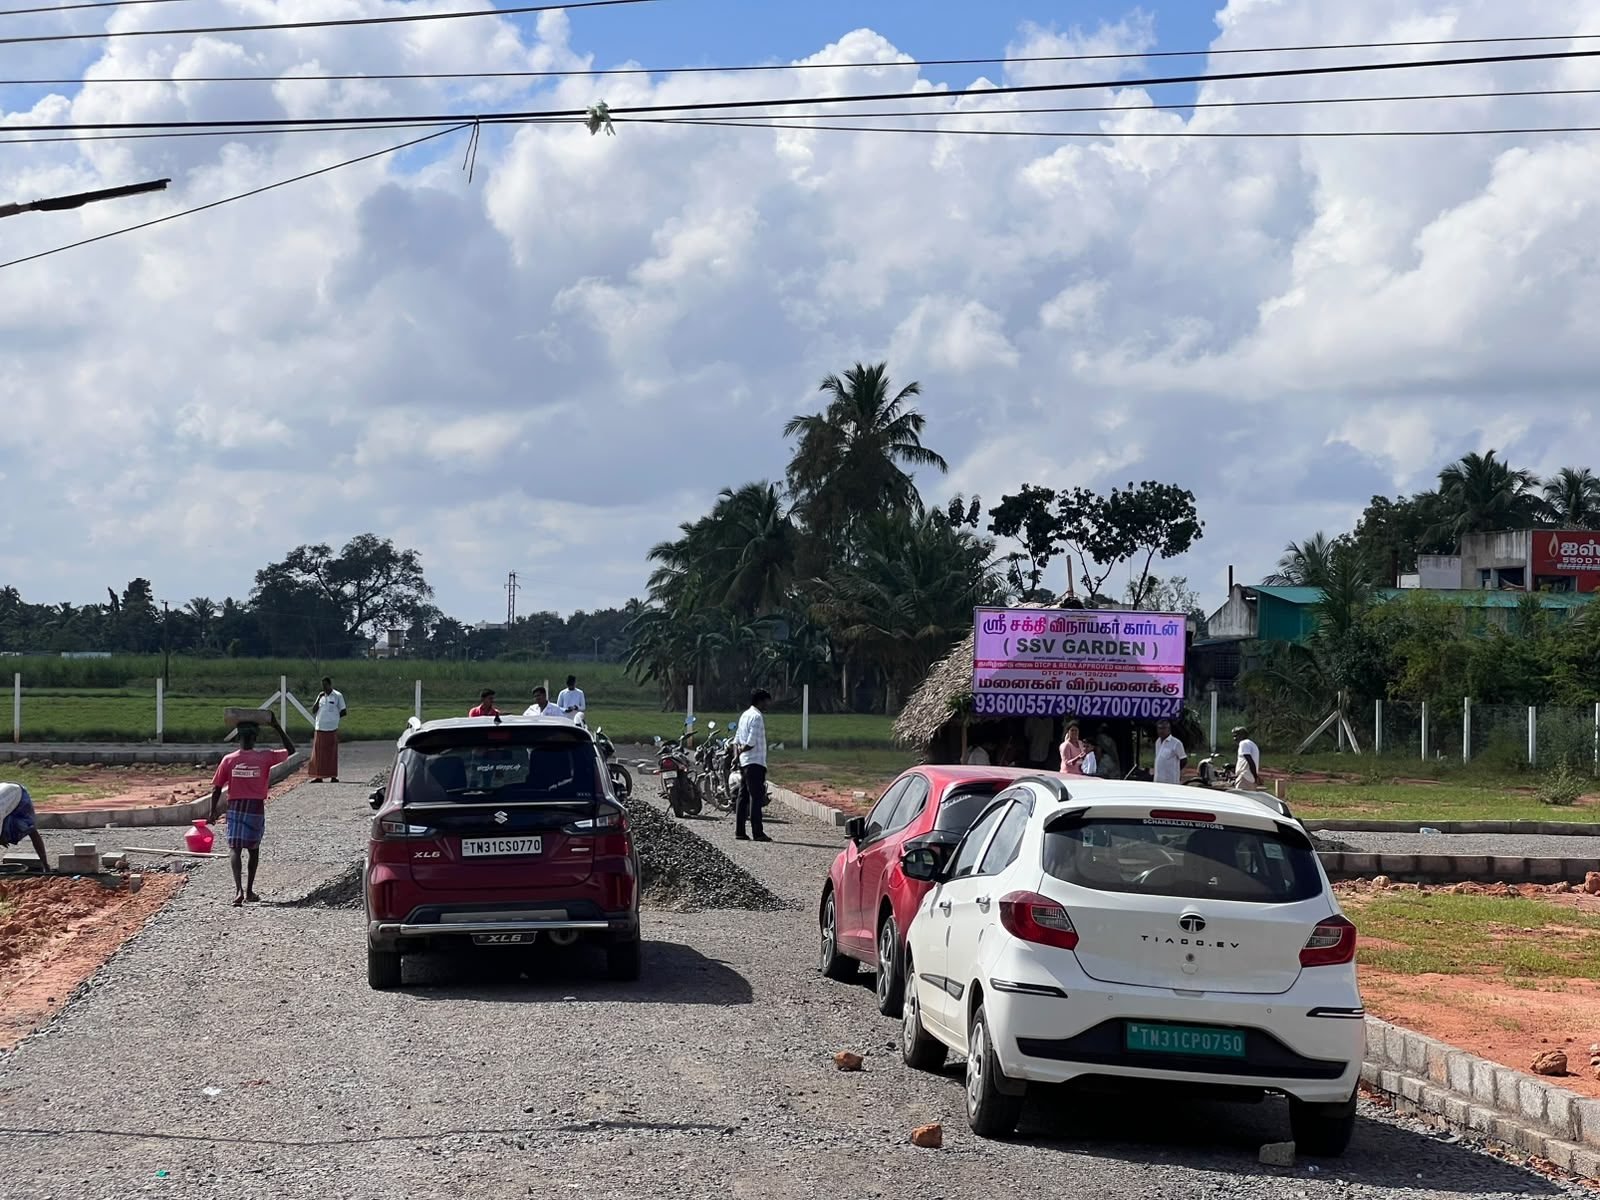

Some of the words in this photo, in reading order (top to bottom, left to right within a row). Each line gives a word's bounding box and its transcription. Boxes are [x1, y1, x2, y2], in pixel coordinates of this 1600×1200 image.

[983, 613, 1007, 635] ஸ்ரீ
[1011, 616, 1048, 636] சக்தி
[1050, 616, 1119, 637] விநாயகர்
[1123, 620, 1179, 637] கார்டன்
[1016, 638, 1056, 654] SSV
[1062, 639, 1146, 657] GARDEN
[1034, 662, 1052, 670] DTCP
[1058, 663, 1077, 671] RERA
[978, 677, 1062, 691] மனைகள்
[1066, 677, 1180, 695] விற்பனைக்கு
[413, 850, 441, 859] XL6
[470, 839, 541, 855] TN31CS0770
[487, 934, 522, 943] XL6
[1140, 1028, 1243, 1053] TN31CP0750
